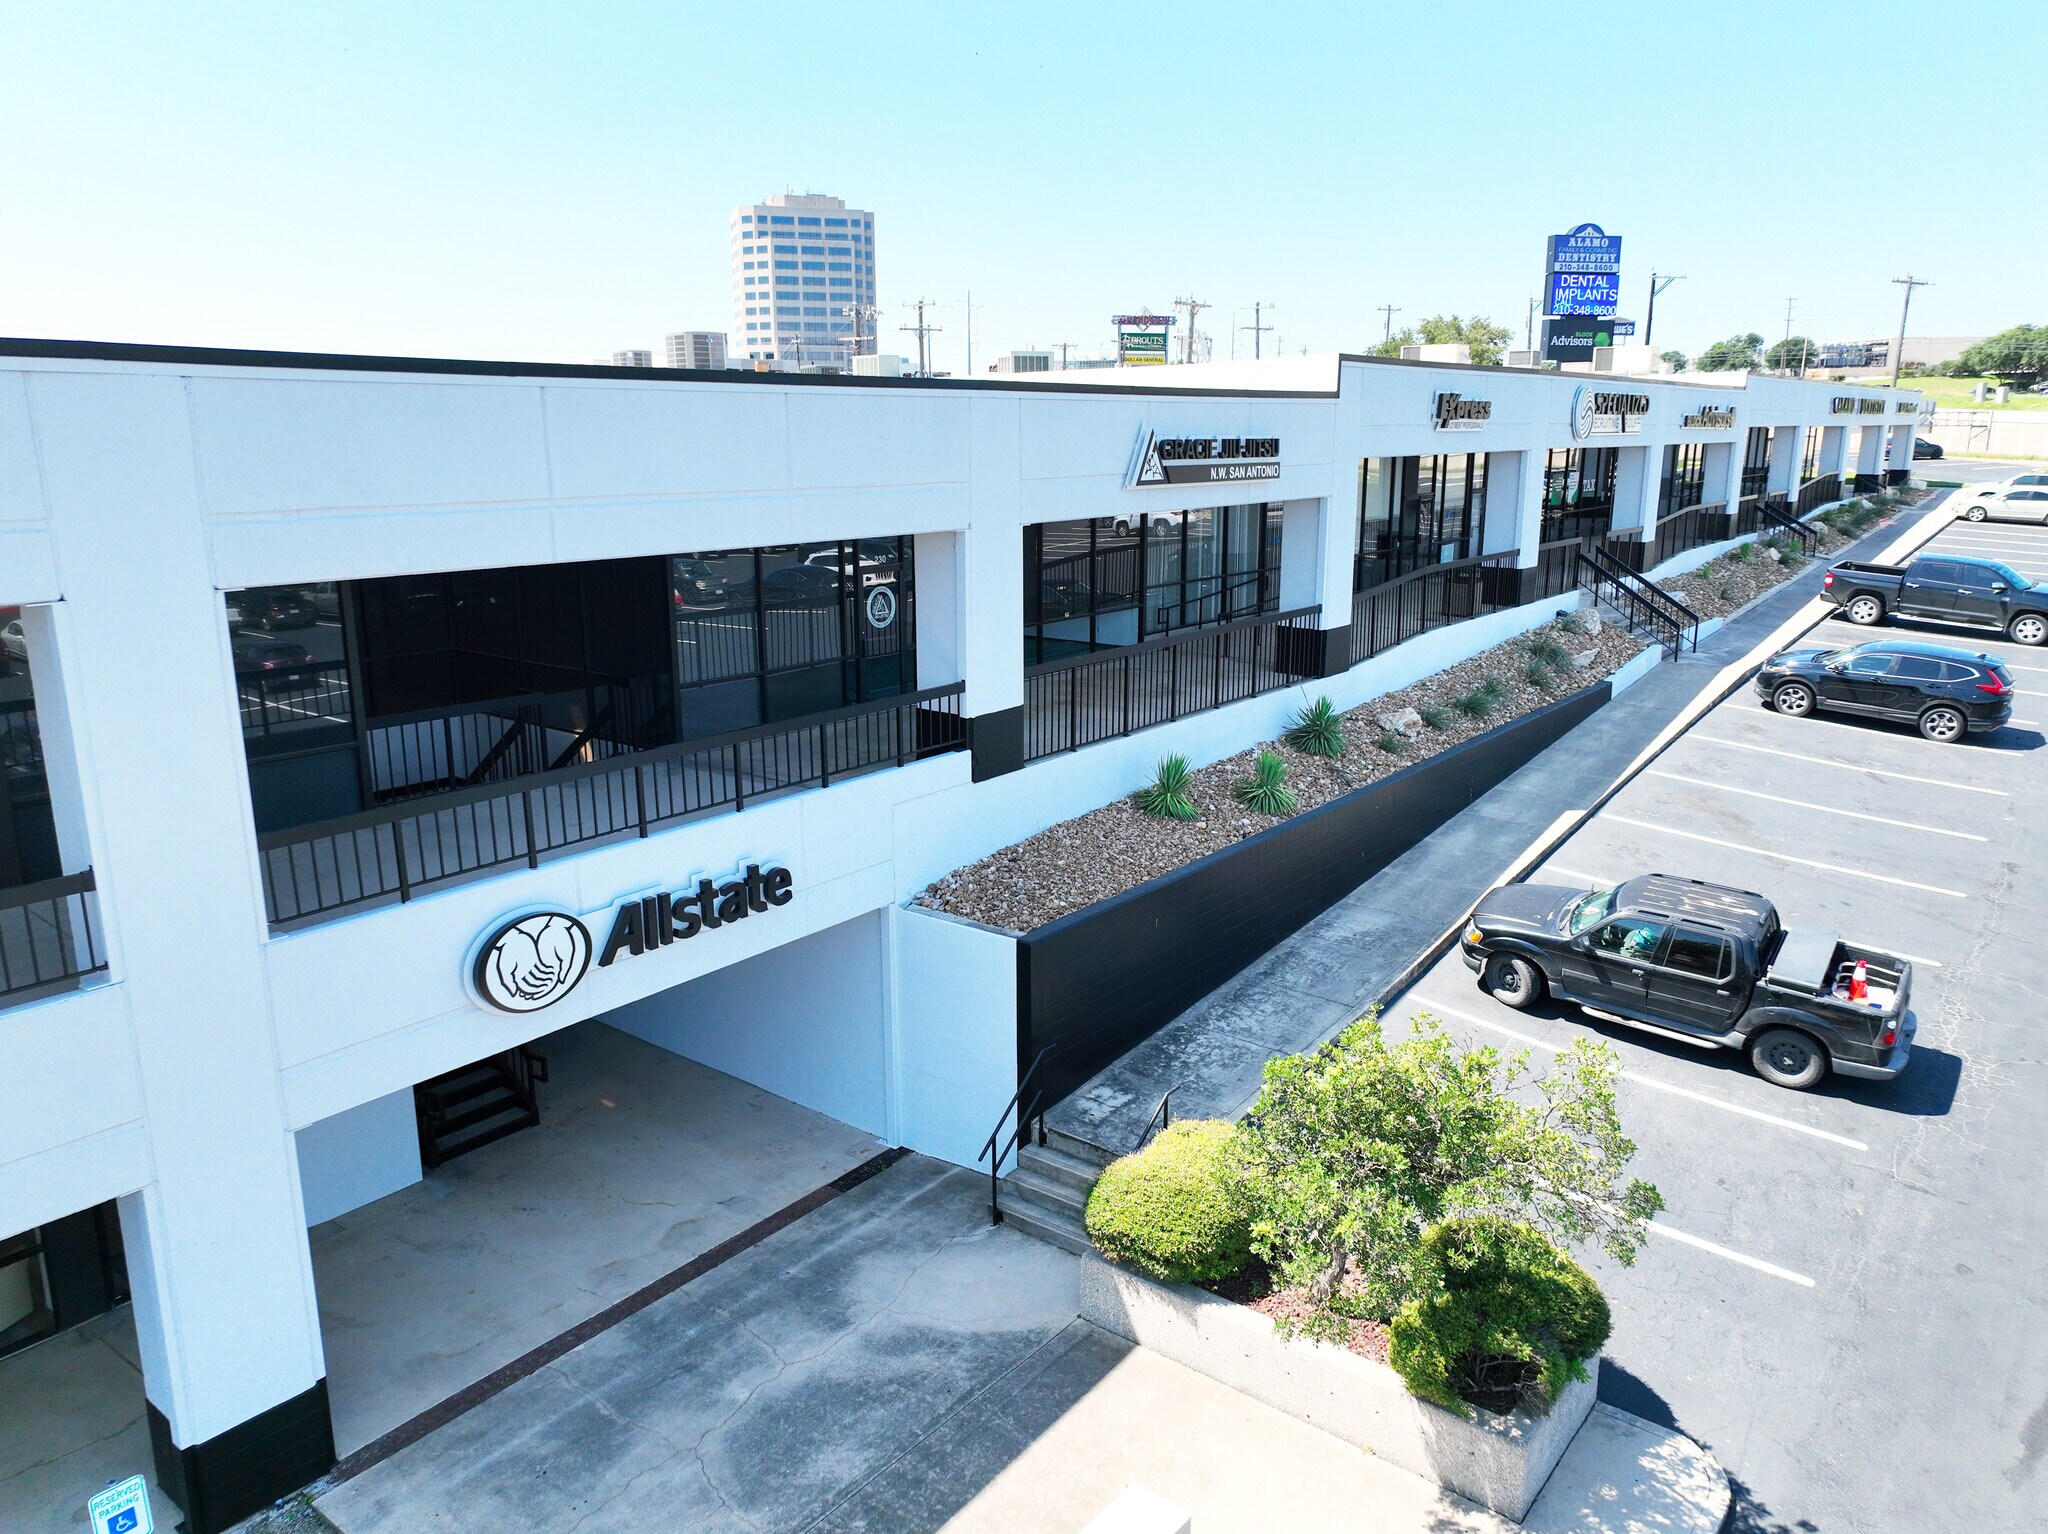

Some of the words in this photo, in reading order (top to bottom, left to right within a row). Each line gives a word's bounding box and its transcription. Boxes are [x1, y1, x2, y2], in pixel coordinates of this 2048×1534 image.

[1568, 238, 1609, 247] ALAMO
[1558, 253, 1617, 262] DENTISTRY
[1561, 275, 1610, 287] DENTAL
[1555, 288, 1617, 301] IMPLANTS
[1552, 305, 1617, 316] 210-348-8600
[1613, 324, 1634, 334] WE'S
[1550, 336, 1593, 346] Advisors
[1159, 438, 1218, 460] GRACIE
[1218, 438, 1280, 459] JIU-JITSU
[1210, 467, 1228, 480] N.W.
[1229, 466, 1248, 479] SAN
[1247, 465, 1280, 478] ANTONIO
[1583, 479, 1596, 491] TAX
[874, 555, 887, 563] 230
[598, 864, 793, 967] Allstate
[93, 1482, 141, 1511] RESERVED
[98, 1493, 139, 1519] PARKING
